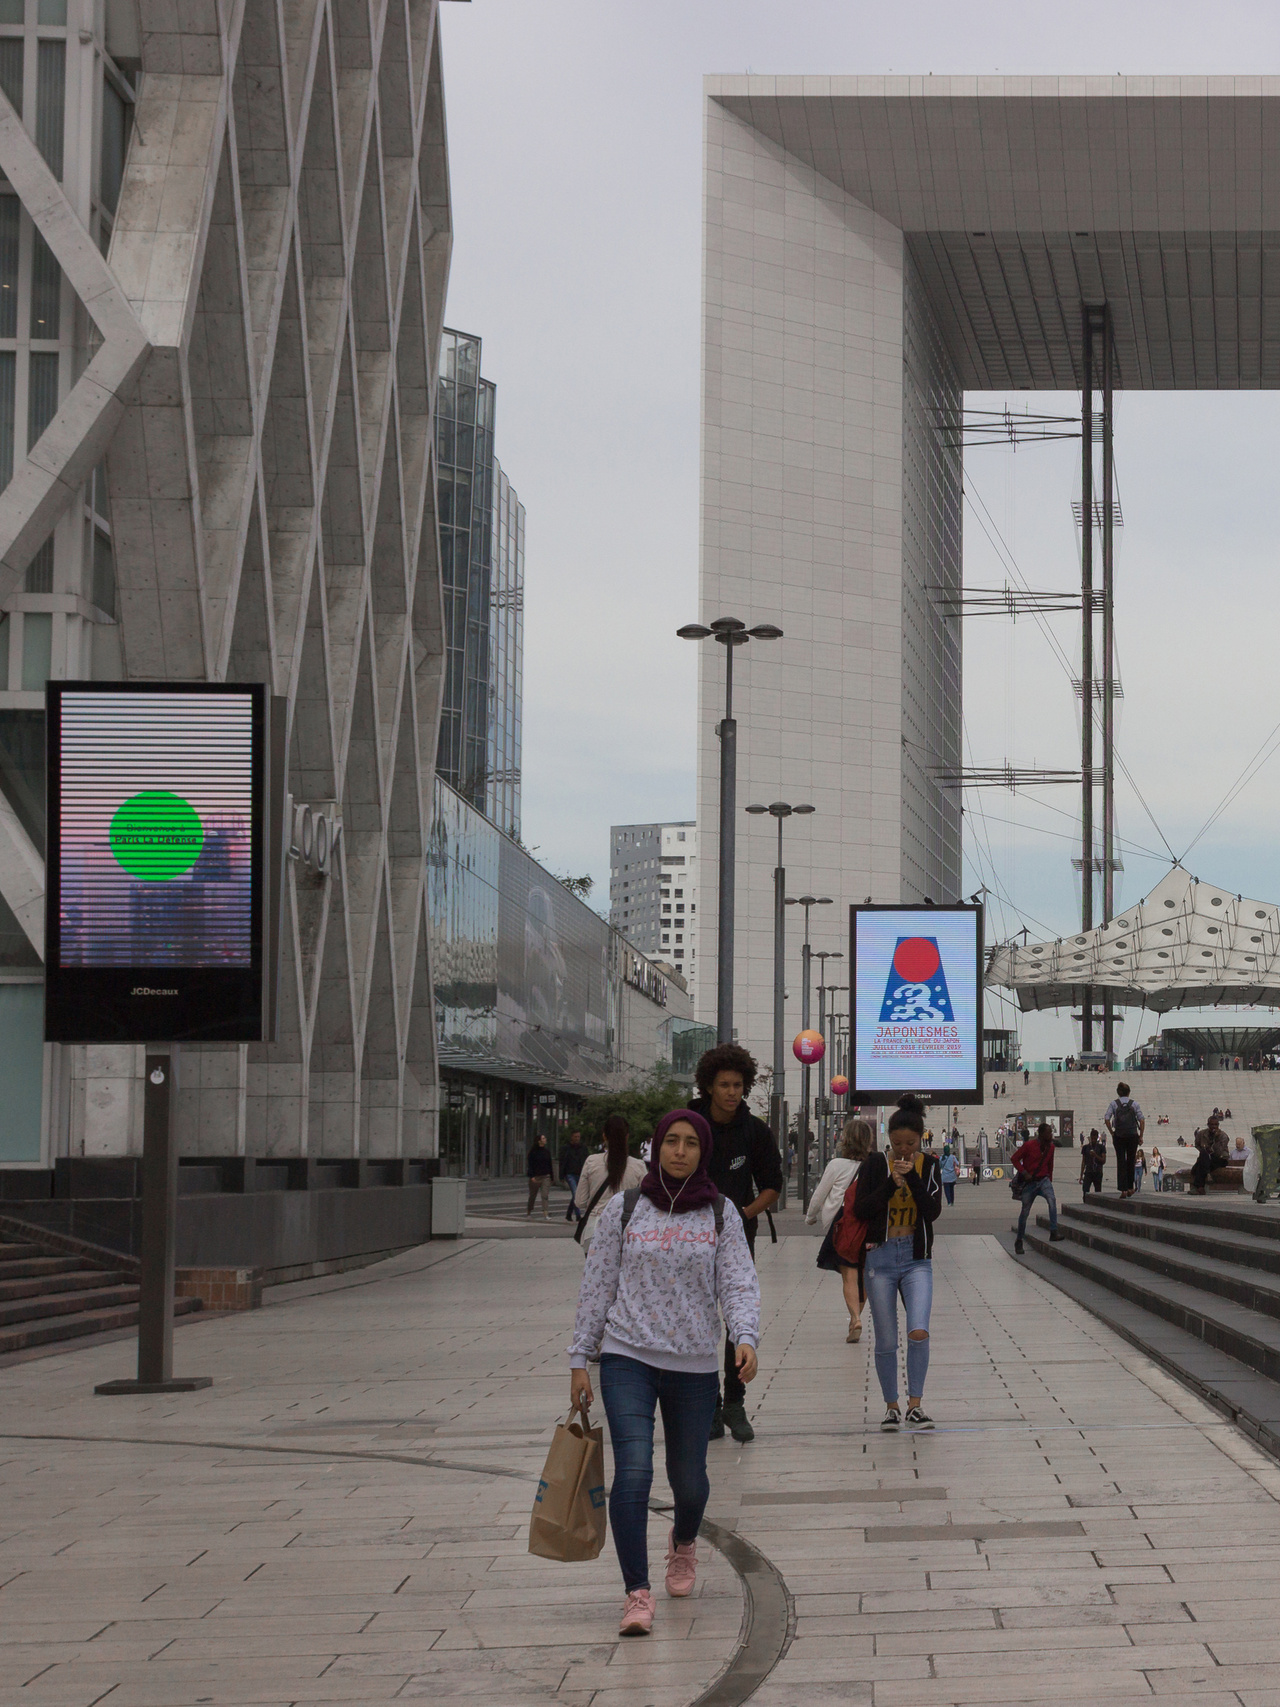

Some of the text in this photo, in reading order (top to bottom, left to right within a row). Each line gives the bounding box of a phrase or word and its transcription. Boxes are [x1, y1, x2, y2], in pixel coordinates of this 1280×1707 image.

[126, 823, 176, 832] Bienvenue
[114, 834, 197, 844] Paris La Défense
[130, 986, 179, 996] JCDecaux
[876, 1026, 958, 1037] JAPONISMES
[918, 1043, 945, 1051] FÉVRIER
[626, 1225, 716, 1251] magical
